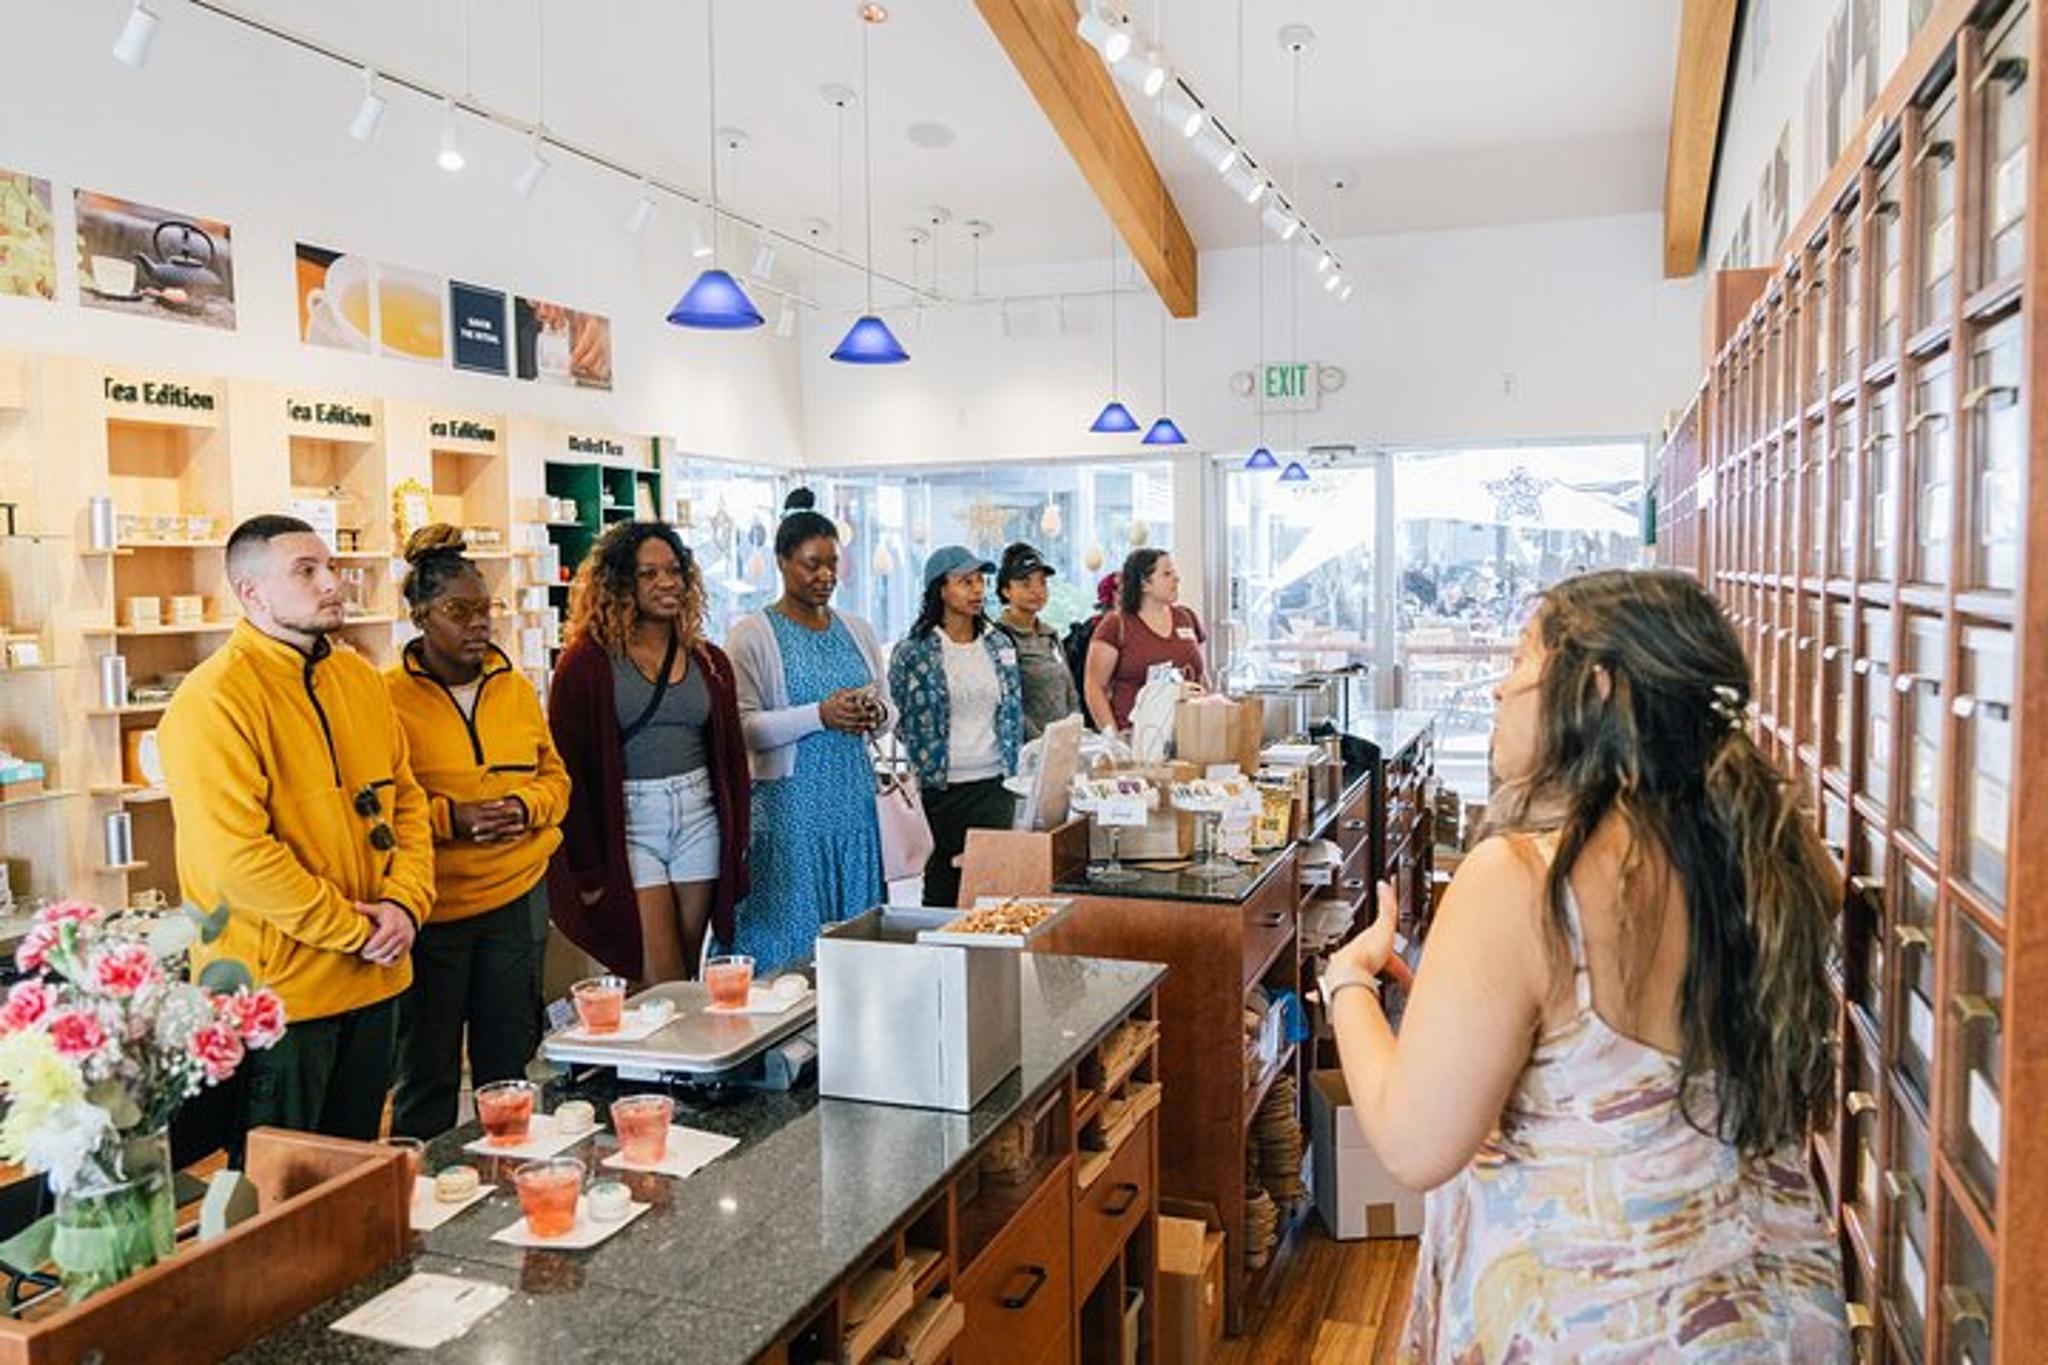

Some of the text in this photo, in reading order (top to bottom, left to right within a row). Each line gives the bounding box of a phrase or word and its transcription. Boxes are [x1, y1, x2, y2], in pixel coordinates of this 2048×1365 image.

[104, 377, 214, 410] Tea Edition
[1265, 364, 1308, 398] EXIT
[286, 398, 372, 427] ea Edition
[429, 417, 496, 442] ea Edition
